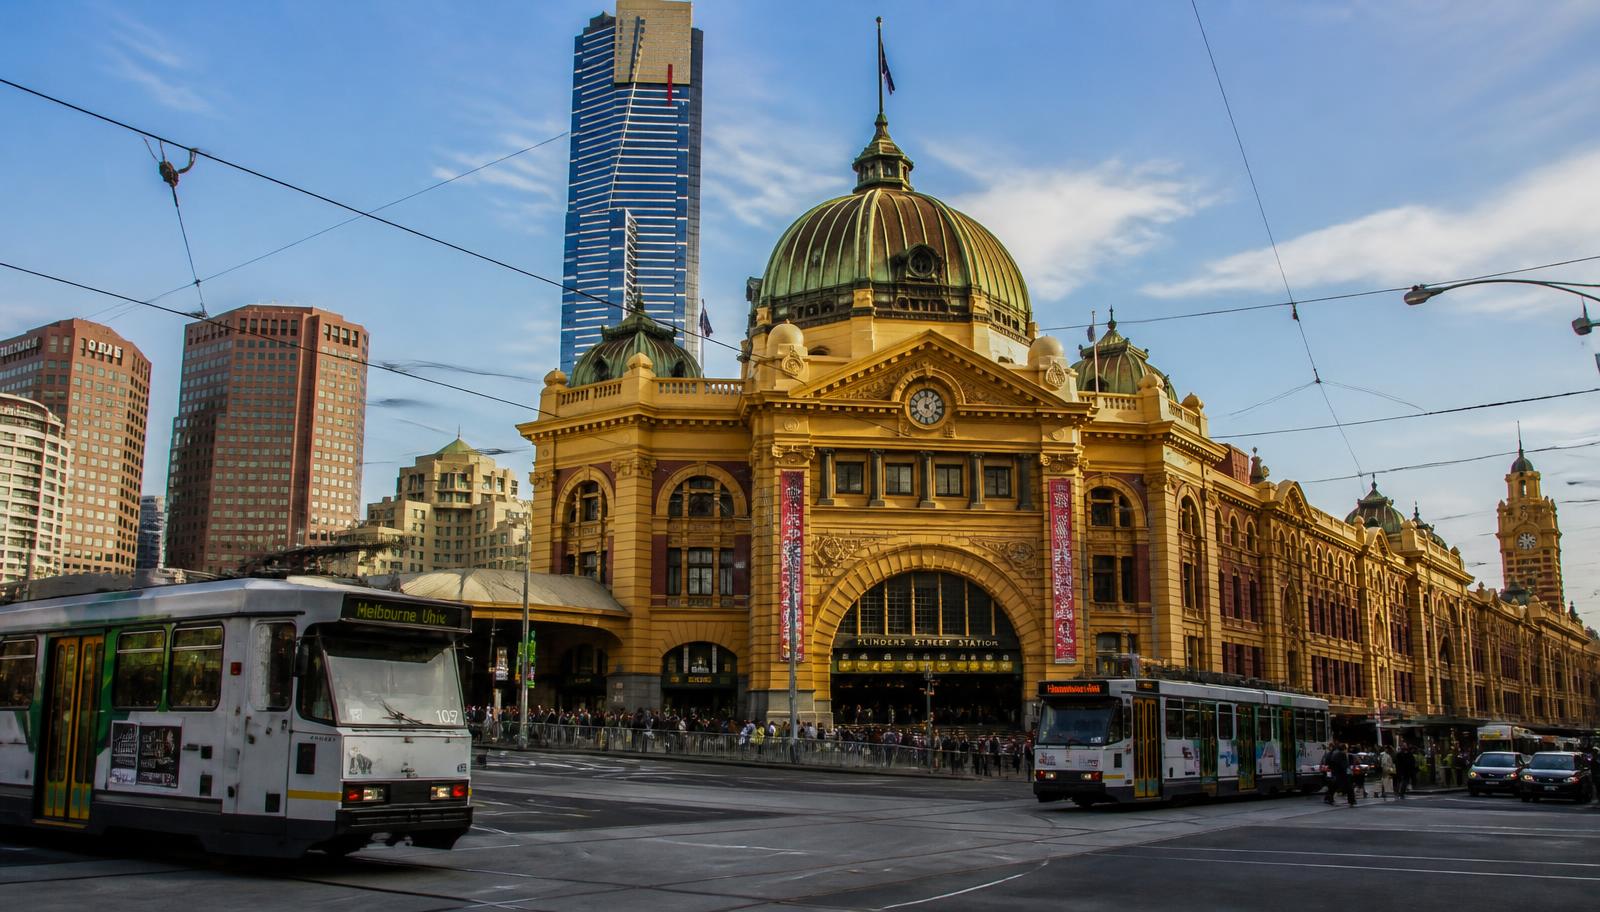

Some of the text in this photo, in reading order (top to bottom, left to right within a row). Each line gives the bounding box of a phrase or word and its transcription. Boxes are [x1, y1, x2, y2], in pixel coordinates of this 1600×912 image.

[356, 602, 417, 622] Melbourne
[857, 638, 999, 647] FLINDERS STREET STATION
